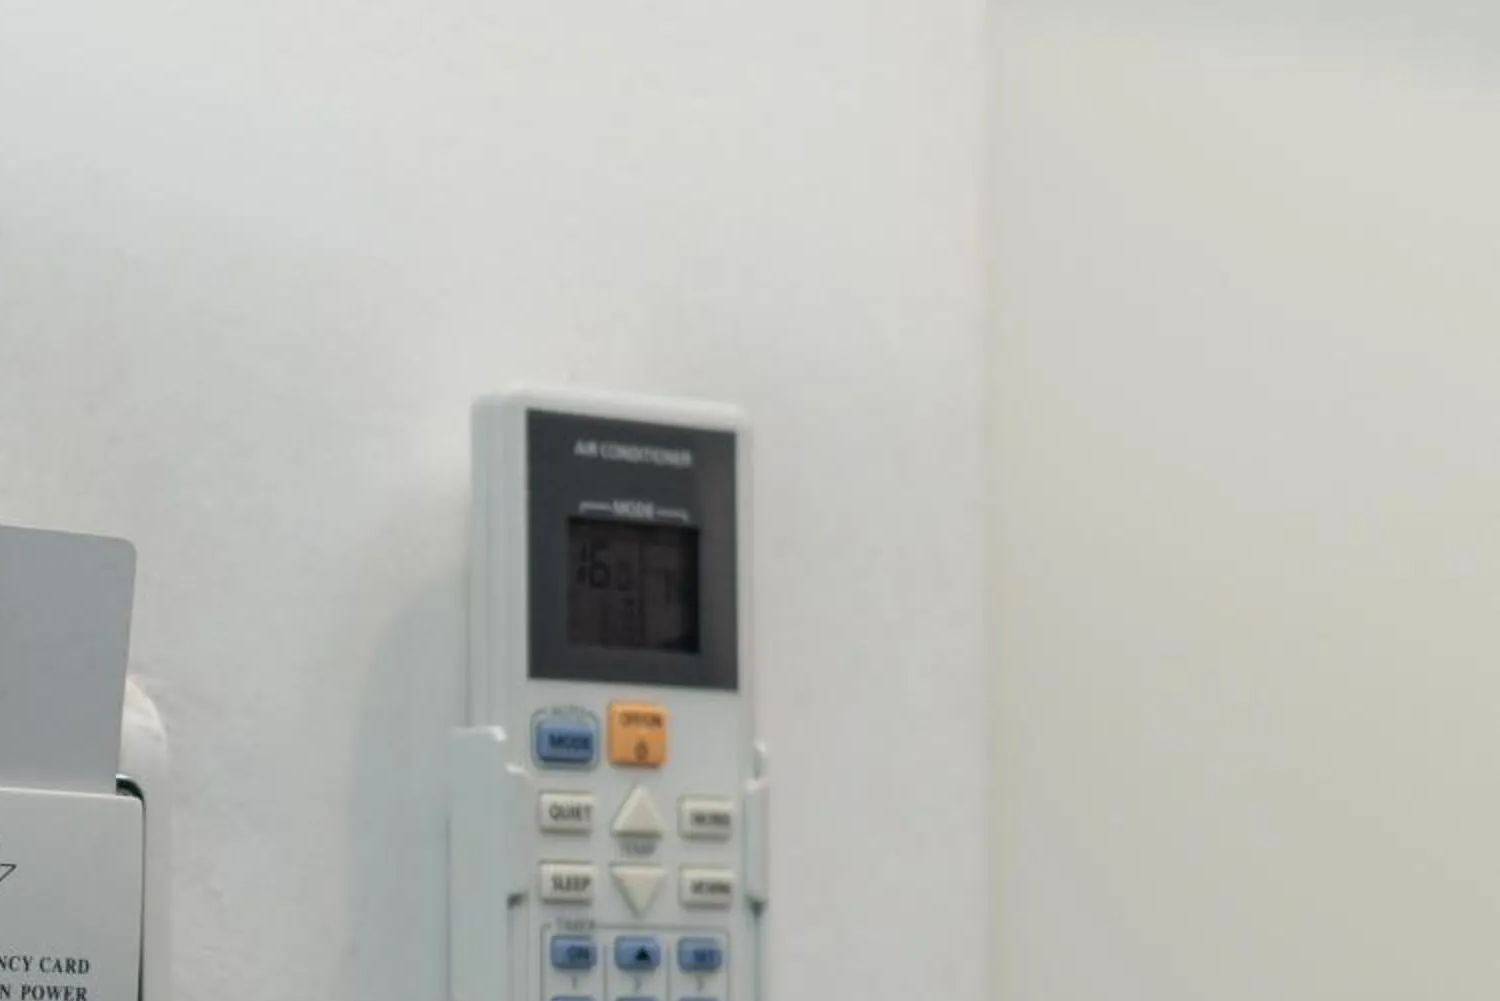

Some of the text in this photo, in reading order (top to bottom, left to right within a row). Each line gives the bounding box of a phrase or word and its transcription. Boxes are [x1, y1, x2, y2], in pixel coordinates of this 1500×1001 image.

[547, 802, 592, 822] QUIET
[551, 874, 592, 892] SLEEP
[39, 957, 91, 975] CARD
